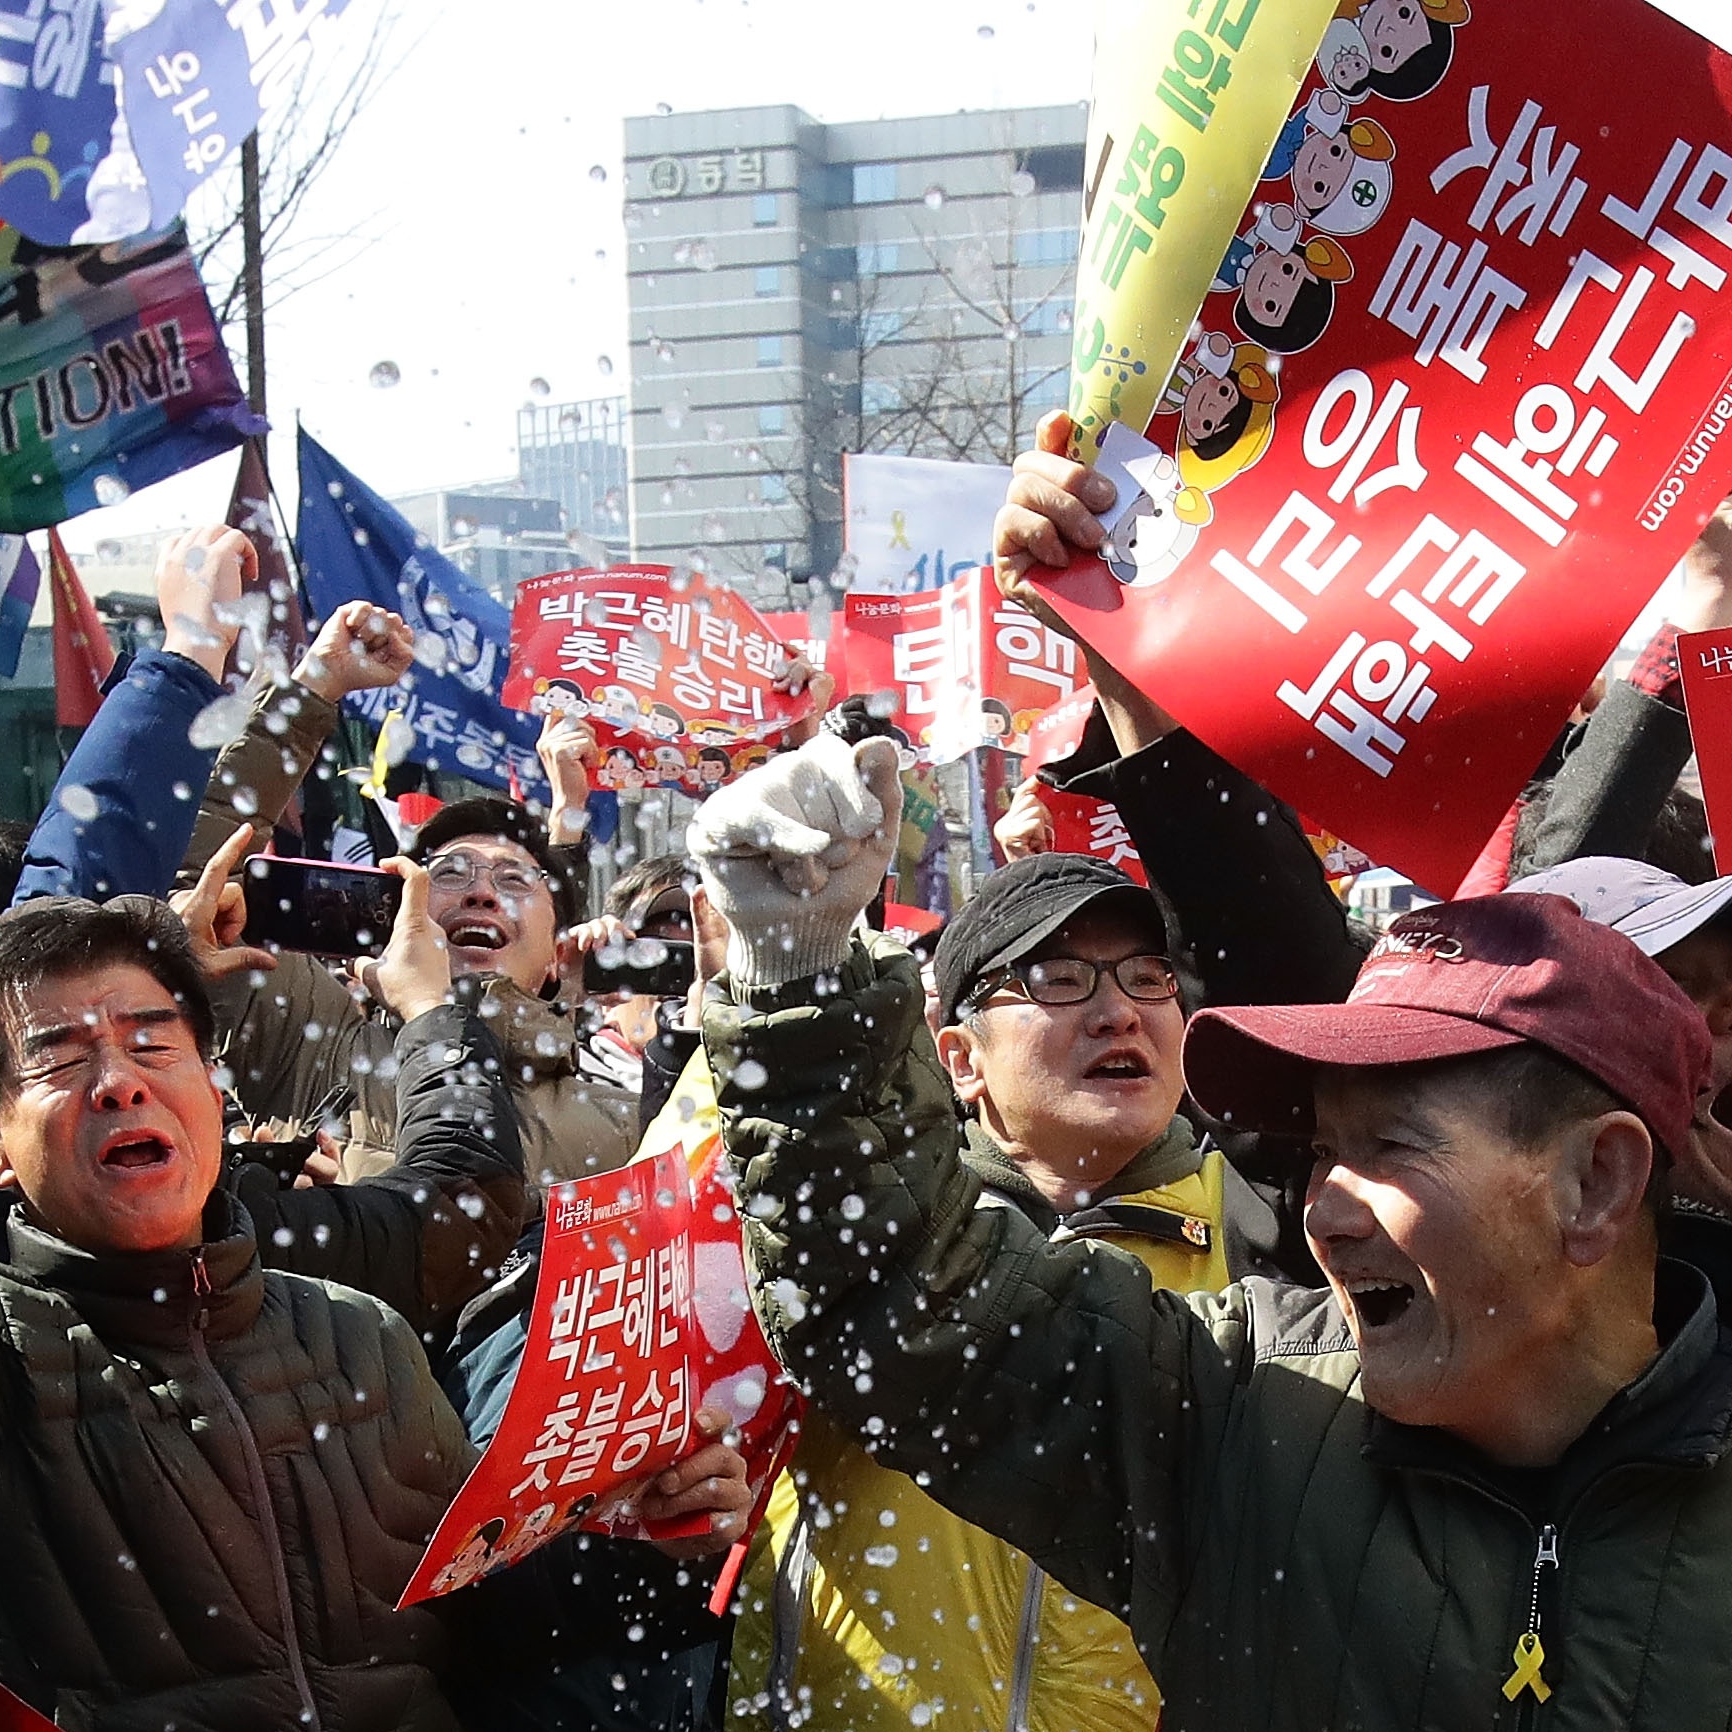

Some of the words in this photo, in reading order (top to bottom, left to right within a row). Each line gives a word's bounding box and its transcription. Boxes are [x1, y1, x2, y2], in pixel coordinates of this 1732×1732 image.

[1367, 84, 1590, 387] 촛불
[1210, 367, 1428, 635] 승리
[538, 590, 691, 650] 박근혜
[698, 612, 785, 680] 탄핵
[556, 630, 663, 691] 촛불
[669, 655, 765, 721] 승리
[1275, 512, 1529, 780] 탄핵
[1089, 803, 1142, 865] 촛
[556, 1195, 593, 1231] 나눔문화
[547, 1248, 657, 1380] 박근혜
[657, 1229, 693, 1349] 탄핵
[509, 1380, 620, 1500] 촛불
[612, 1354, 693, 1473] 승리
